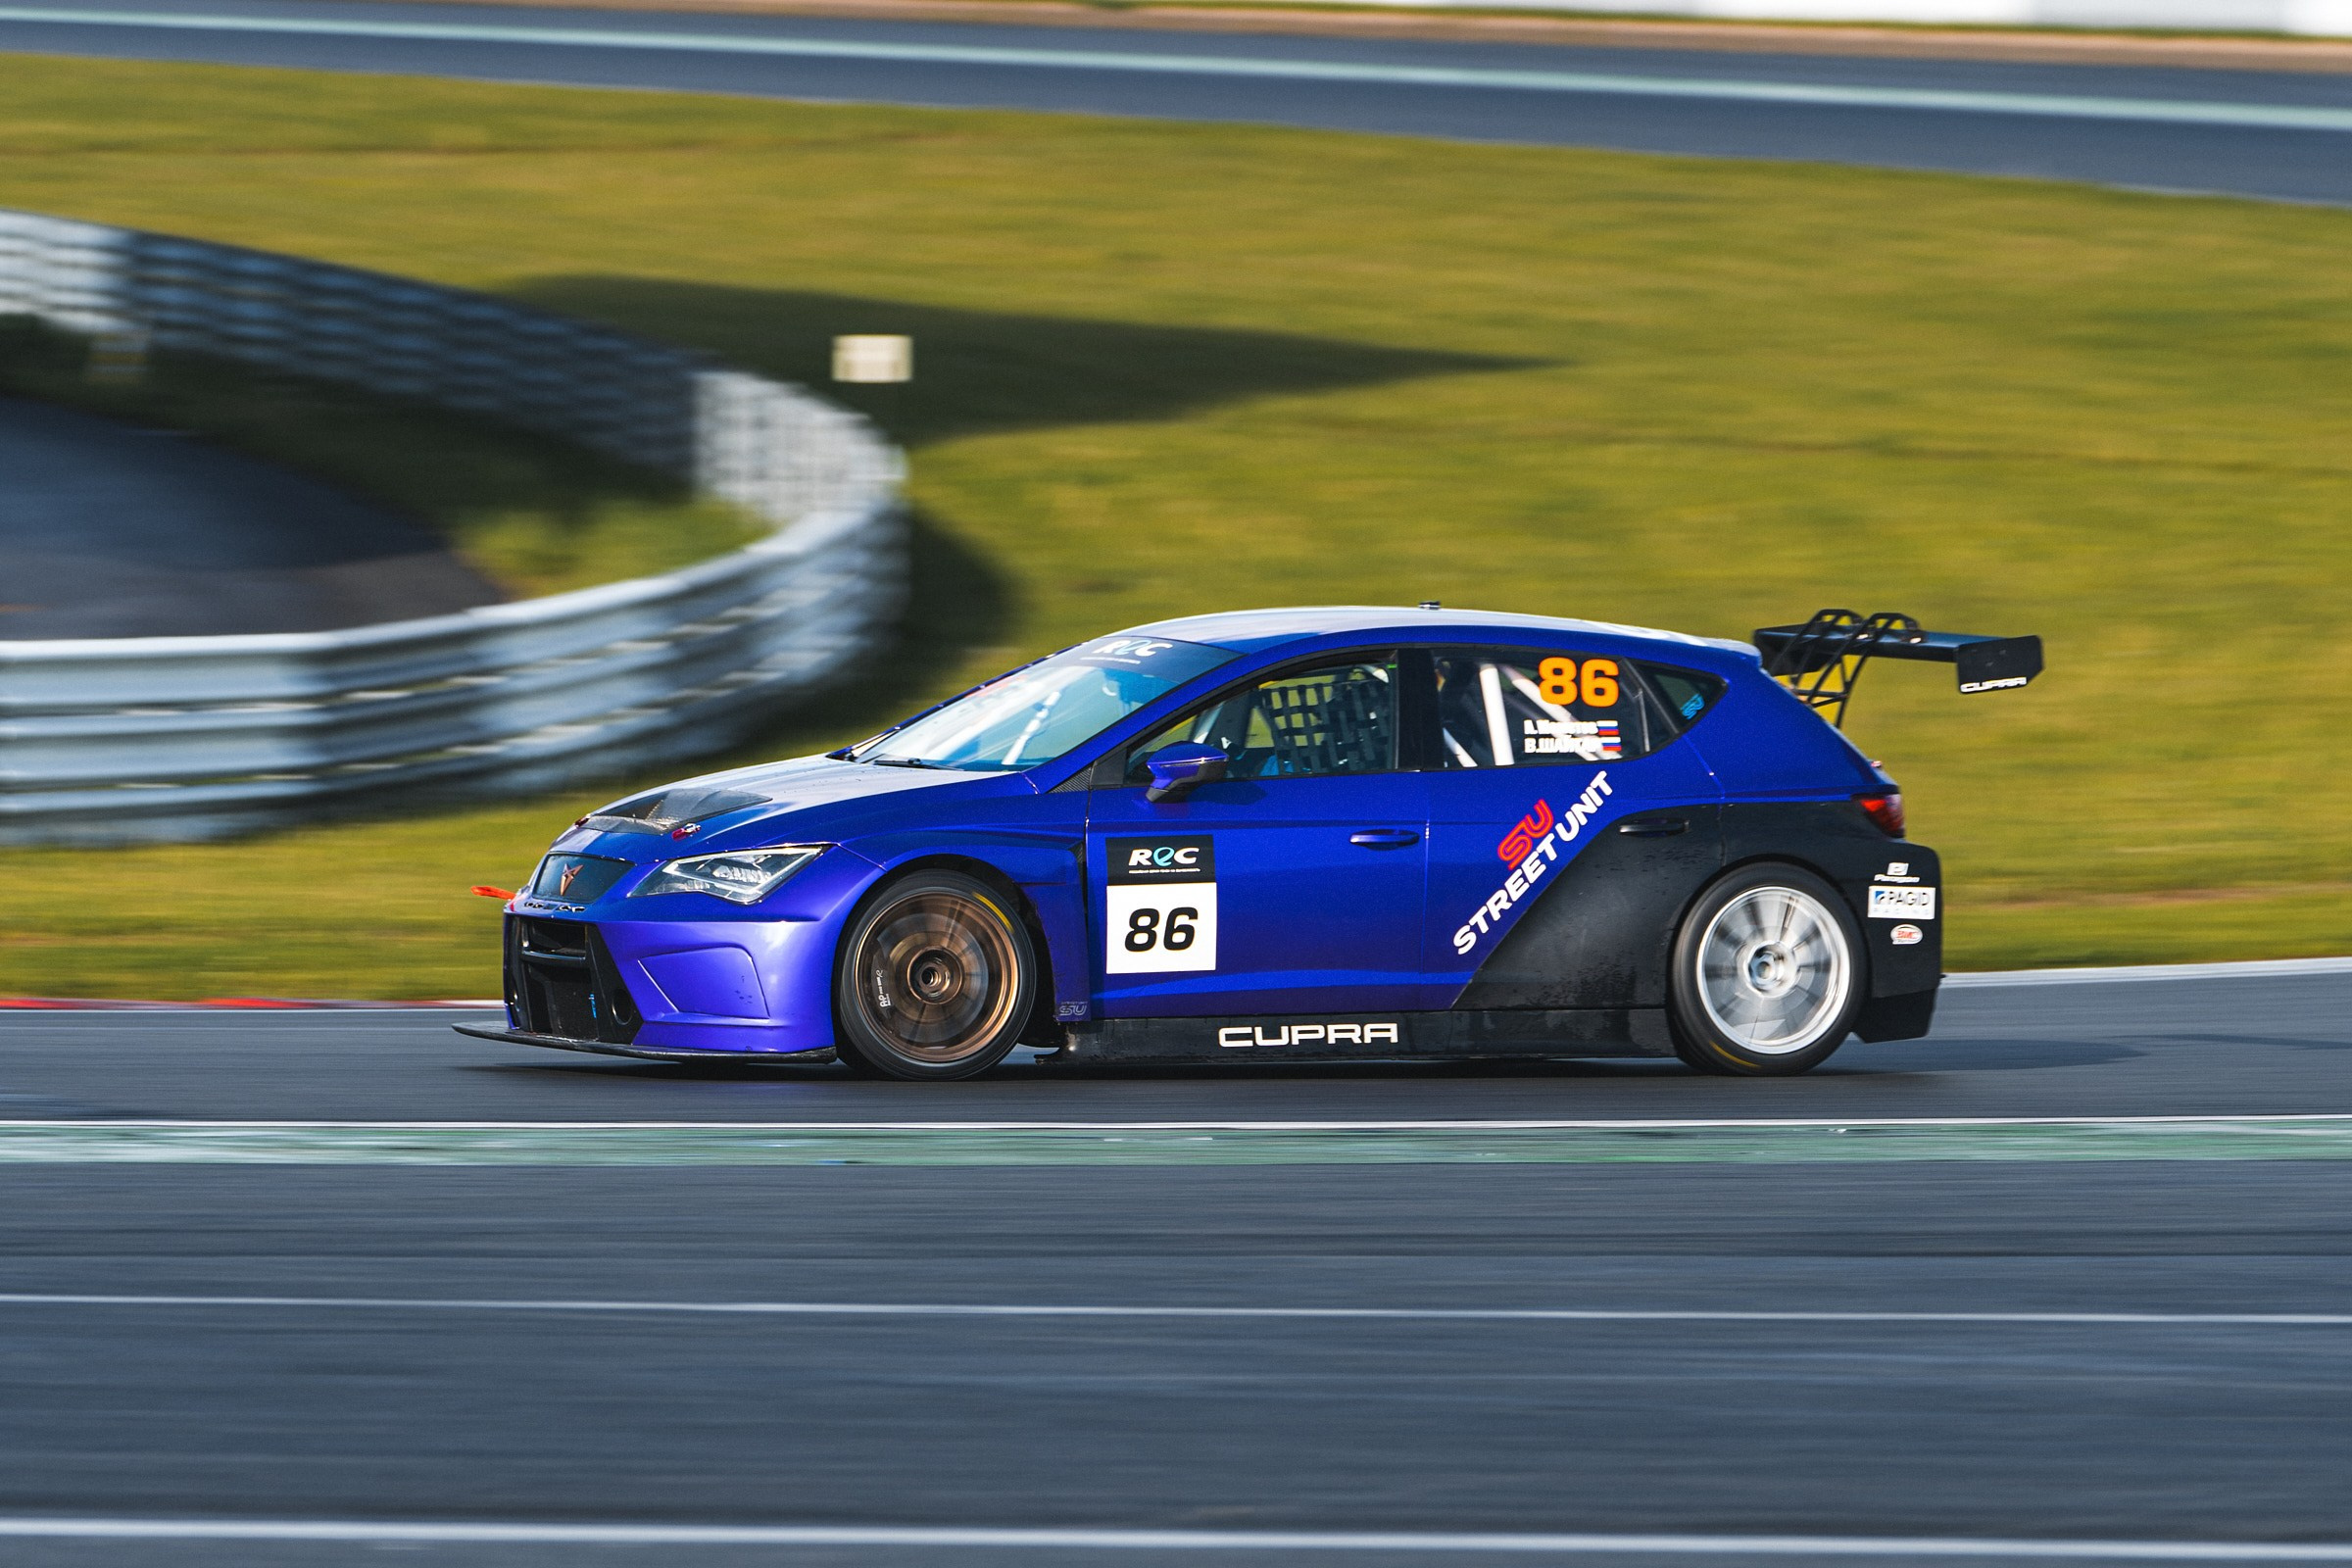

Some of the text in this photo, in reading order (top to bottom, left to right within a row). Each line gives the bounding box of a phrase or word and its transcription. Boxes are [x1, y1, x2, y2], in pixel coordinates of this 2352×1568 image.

[1539, 657, 1620, 708] 86
[1960, 677, 2027, 693] CUPRA
[1497, 799, 1554, 871] SU
[1453, 833, 1557, 956] STREET
[1554, 770, 1613, 842] UNIT
[1887, 891, 1930, 906] PAGID
[1124, 906, 1199, 953] 86
[1218, 1022, 1398, 1048] CUPRA
